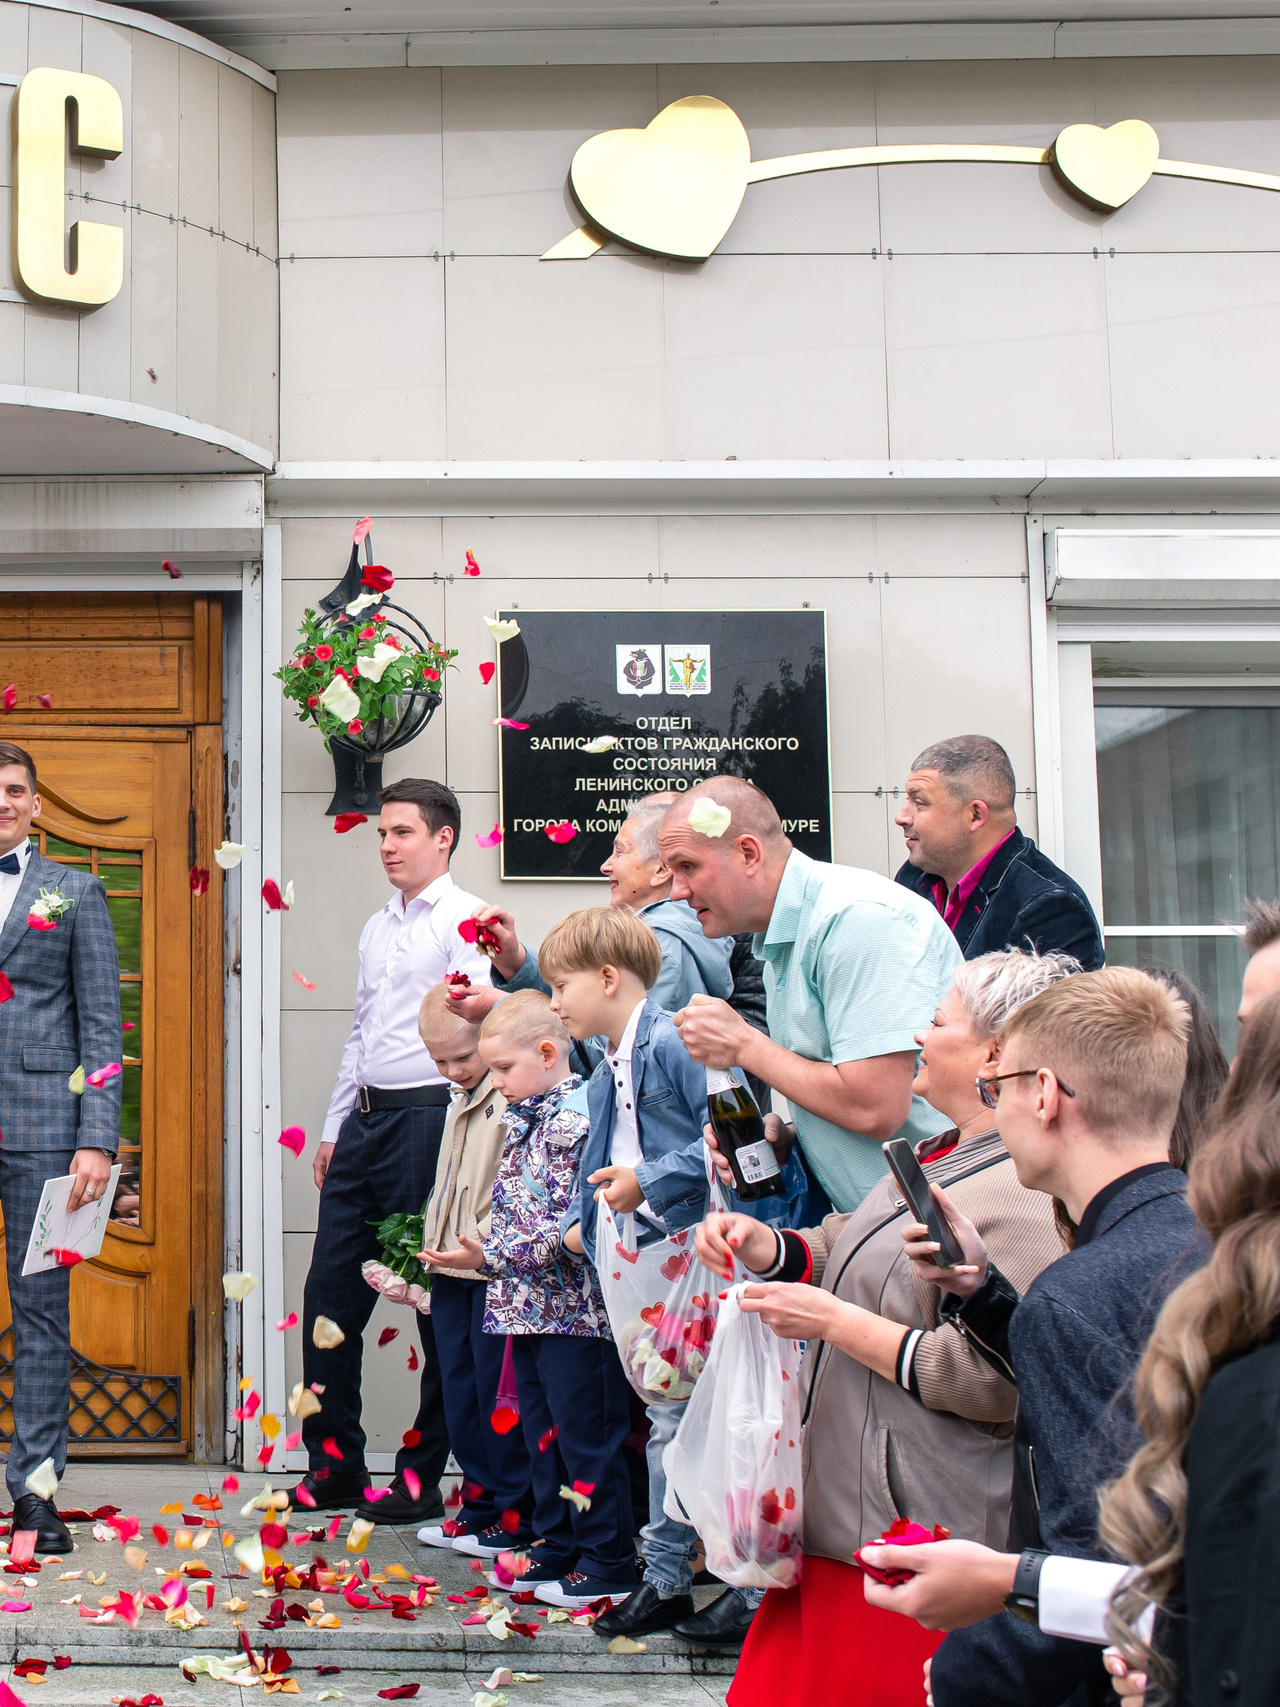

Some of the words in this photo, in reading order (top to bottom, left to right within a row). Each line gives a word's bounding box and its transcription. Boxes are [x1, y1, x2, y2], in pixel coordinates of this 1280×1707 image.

[635, 716, 692, 732] ОТДЕЛ
[607, 736, 659, 751] КТОВ
[663, 736, 800, 753] ГРАЖДАНСКОГО
[612, 757, 717, 771] СОСТОЯНИЯ
[574, 777, 688, 791] ЛЕНИНСКОГО
[513, 818, 582, 832] ГОРОА
